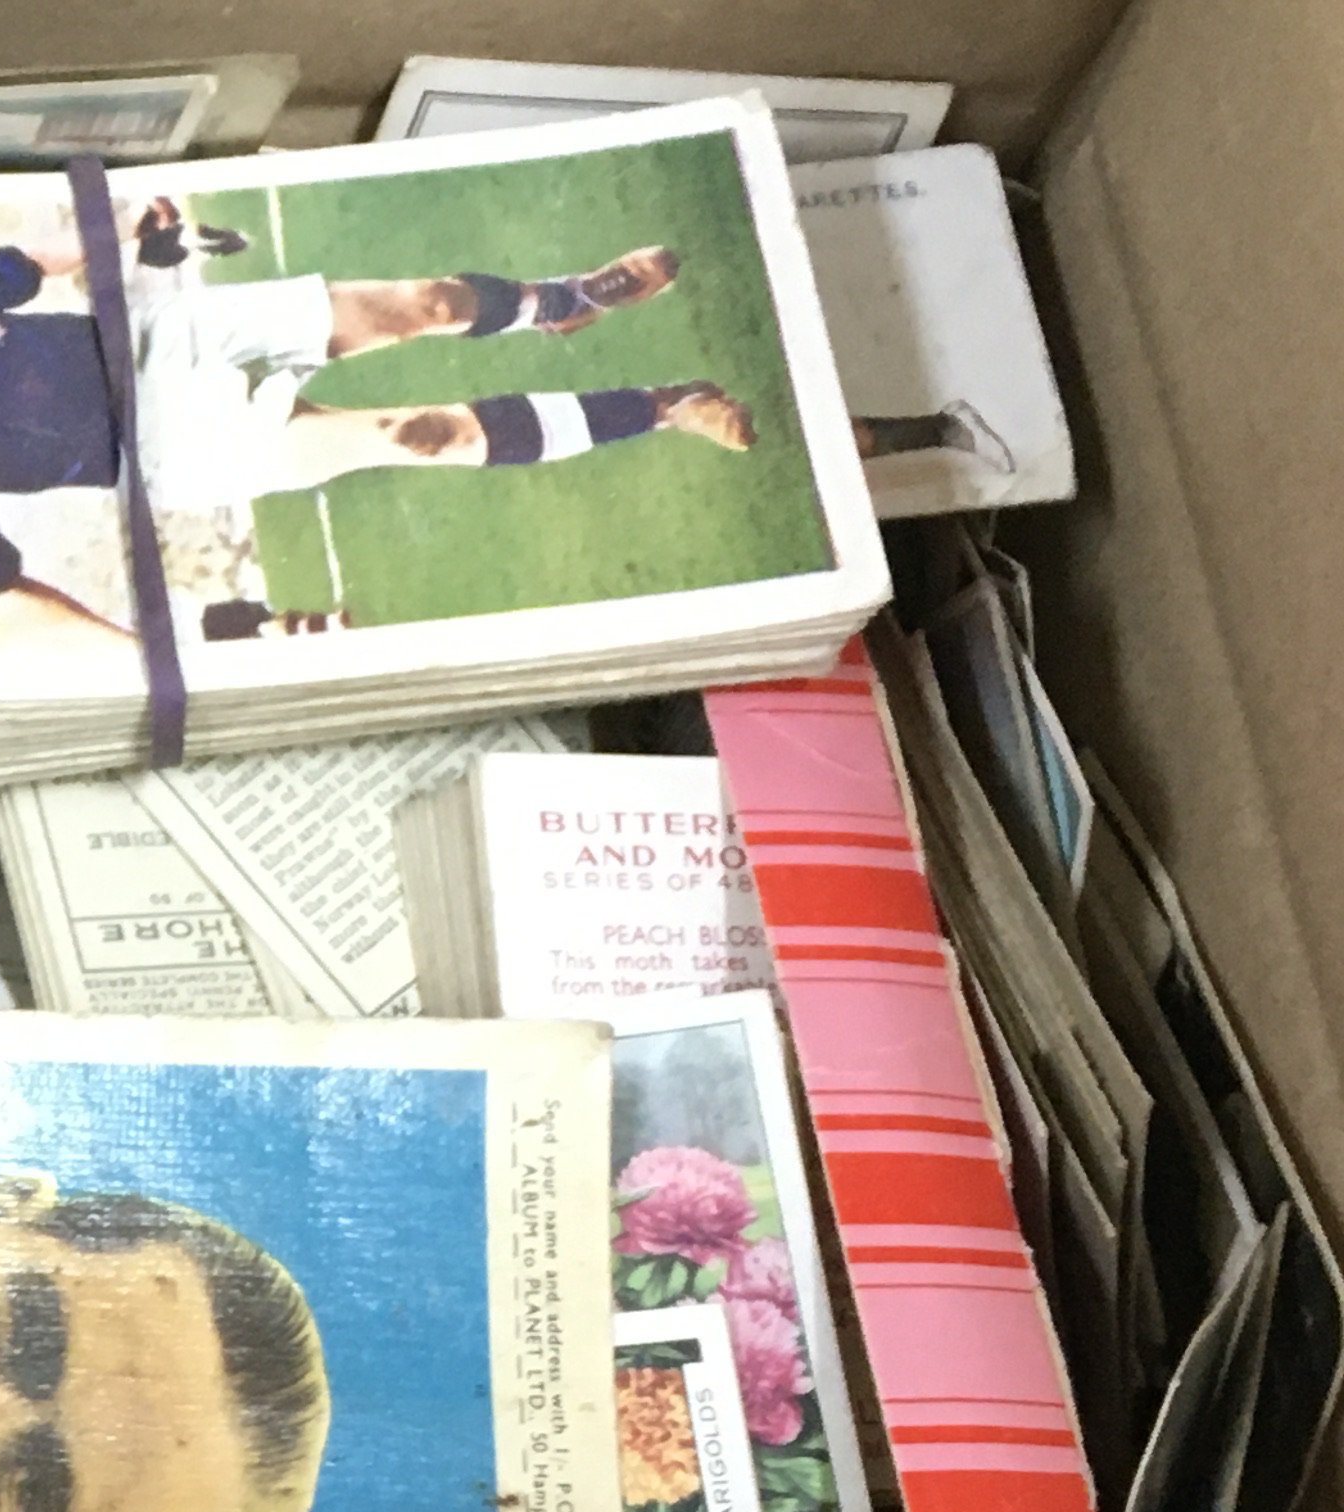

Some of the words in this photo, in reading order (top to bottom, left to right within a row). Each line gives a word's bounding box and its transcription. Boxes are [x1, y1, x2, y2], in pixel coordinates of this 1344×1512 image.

[574, 842, 656, 867] AND
[543, 869, 654, 891] SERIES
[667, 872, 702, 892] OF
[717, 873, 753, 893] 48
[197, 939, 250, 959] HE
[603, 923, 686, 947] PEACH
[548, 949, 596, 969] This
[614, 951, 672, 971] moth
[692, 950, 749, 972] takes
[551, 975, 604, 996] from
[611, 976, 647, 995] the
[540, 1098, 561, 1144] Send
[538, 1155, 557, 1198] your
[519, 1163, 541, 1238] ALBUM
[541, 1210, 559, 1259] name
[522, 1247, 539, 1268] to
[544, 1269, 562, 1303] and
[523, 1277, 543, 1357] PLANET
[546, 1312, 566, 1383] address
[550, 1393, 569, 1435] with
[531, 1430, 547, 1452] 50
